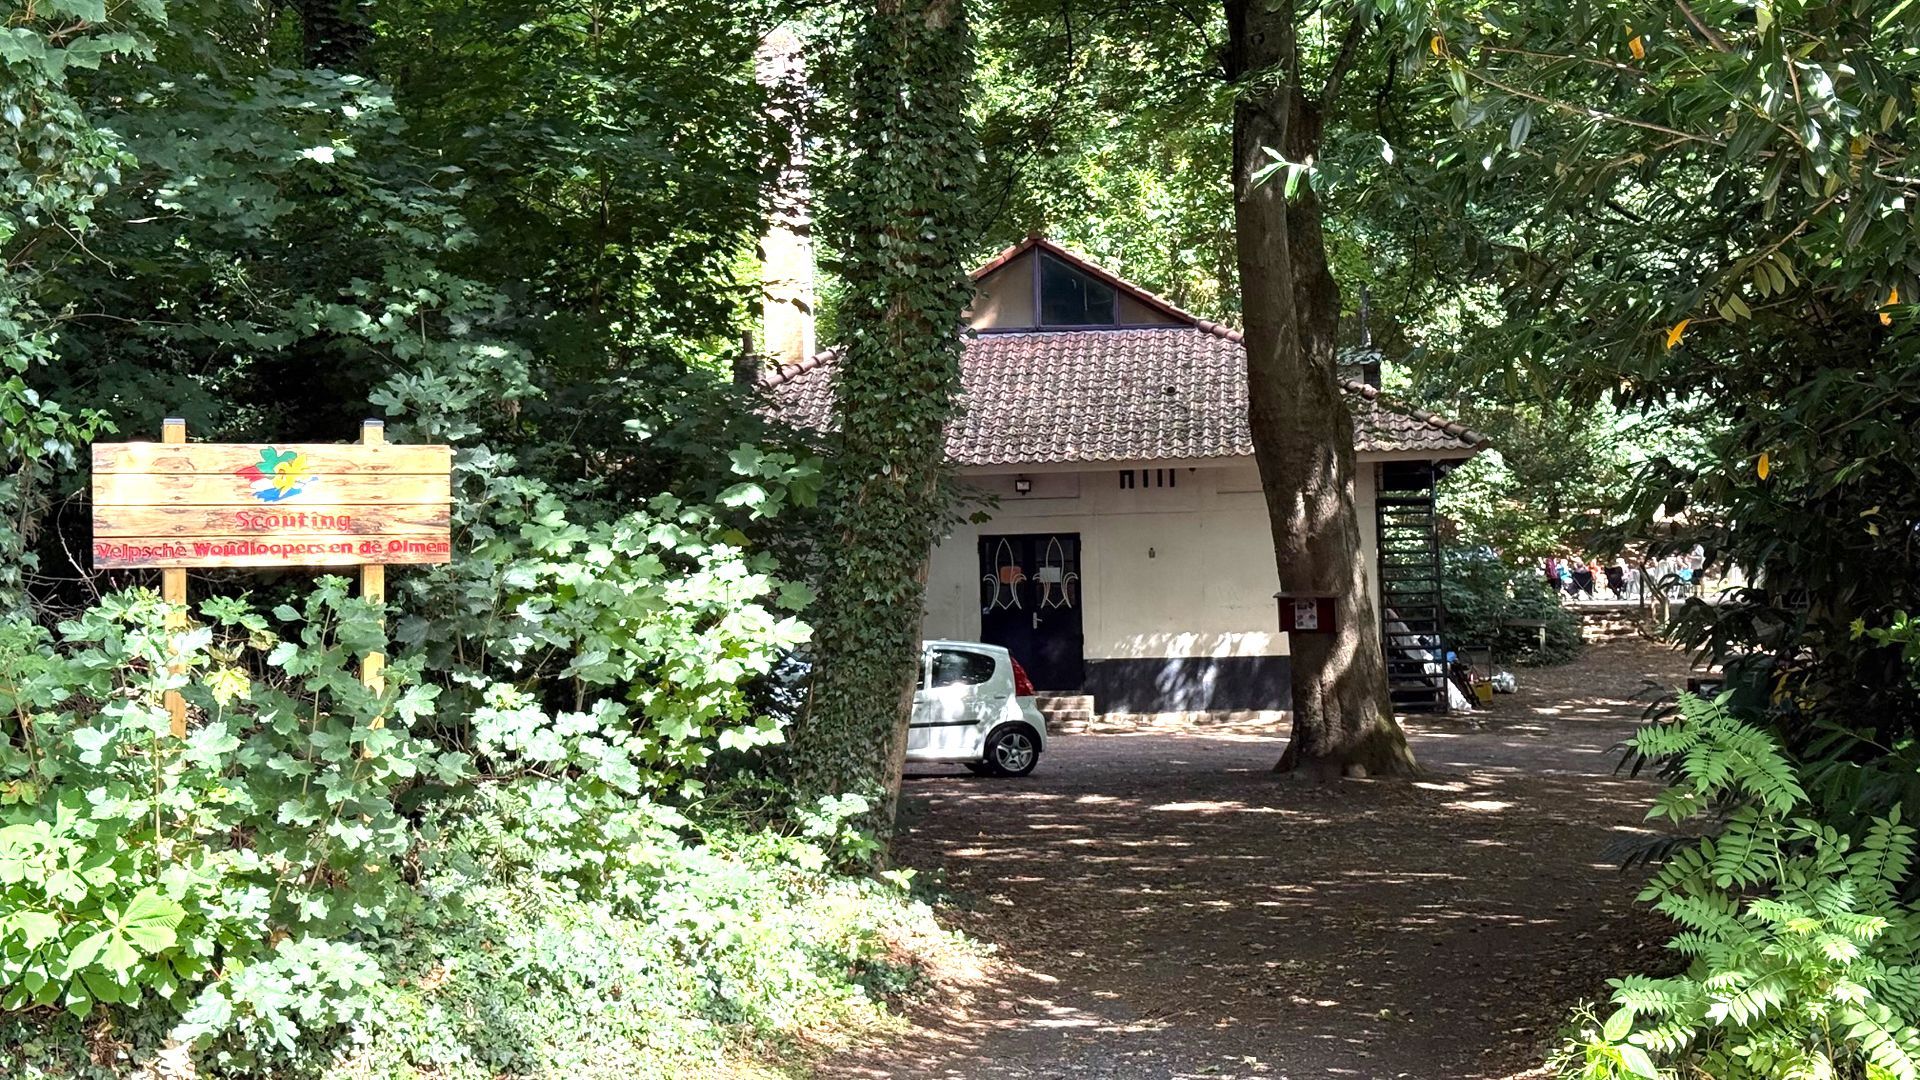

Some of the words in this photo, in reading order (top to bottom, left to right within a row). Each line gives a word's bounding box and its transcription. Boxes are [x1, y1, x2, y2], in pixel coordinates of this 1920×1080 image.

[236, 511, 351, 531] Scouting
[97, 543, 187, 562] Velpsche
[193, 542, 325, 559] Woudloopers
[329, 543, 353, 554] en
[359, 541, 382, 554] de
[388, 540, 449, 553] Olmen
